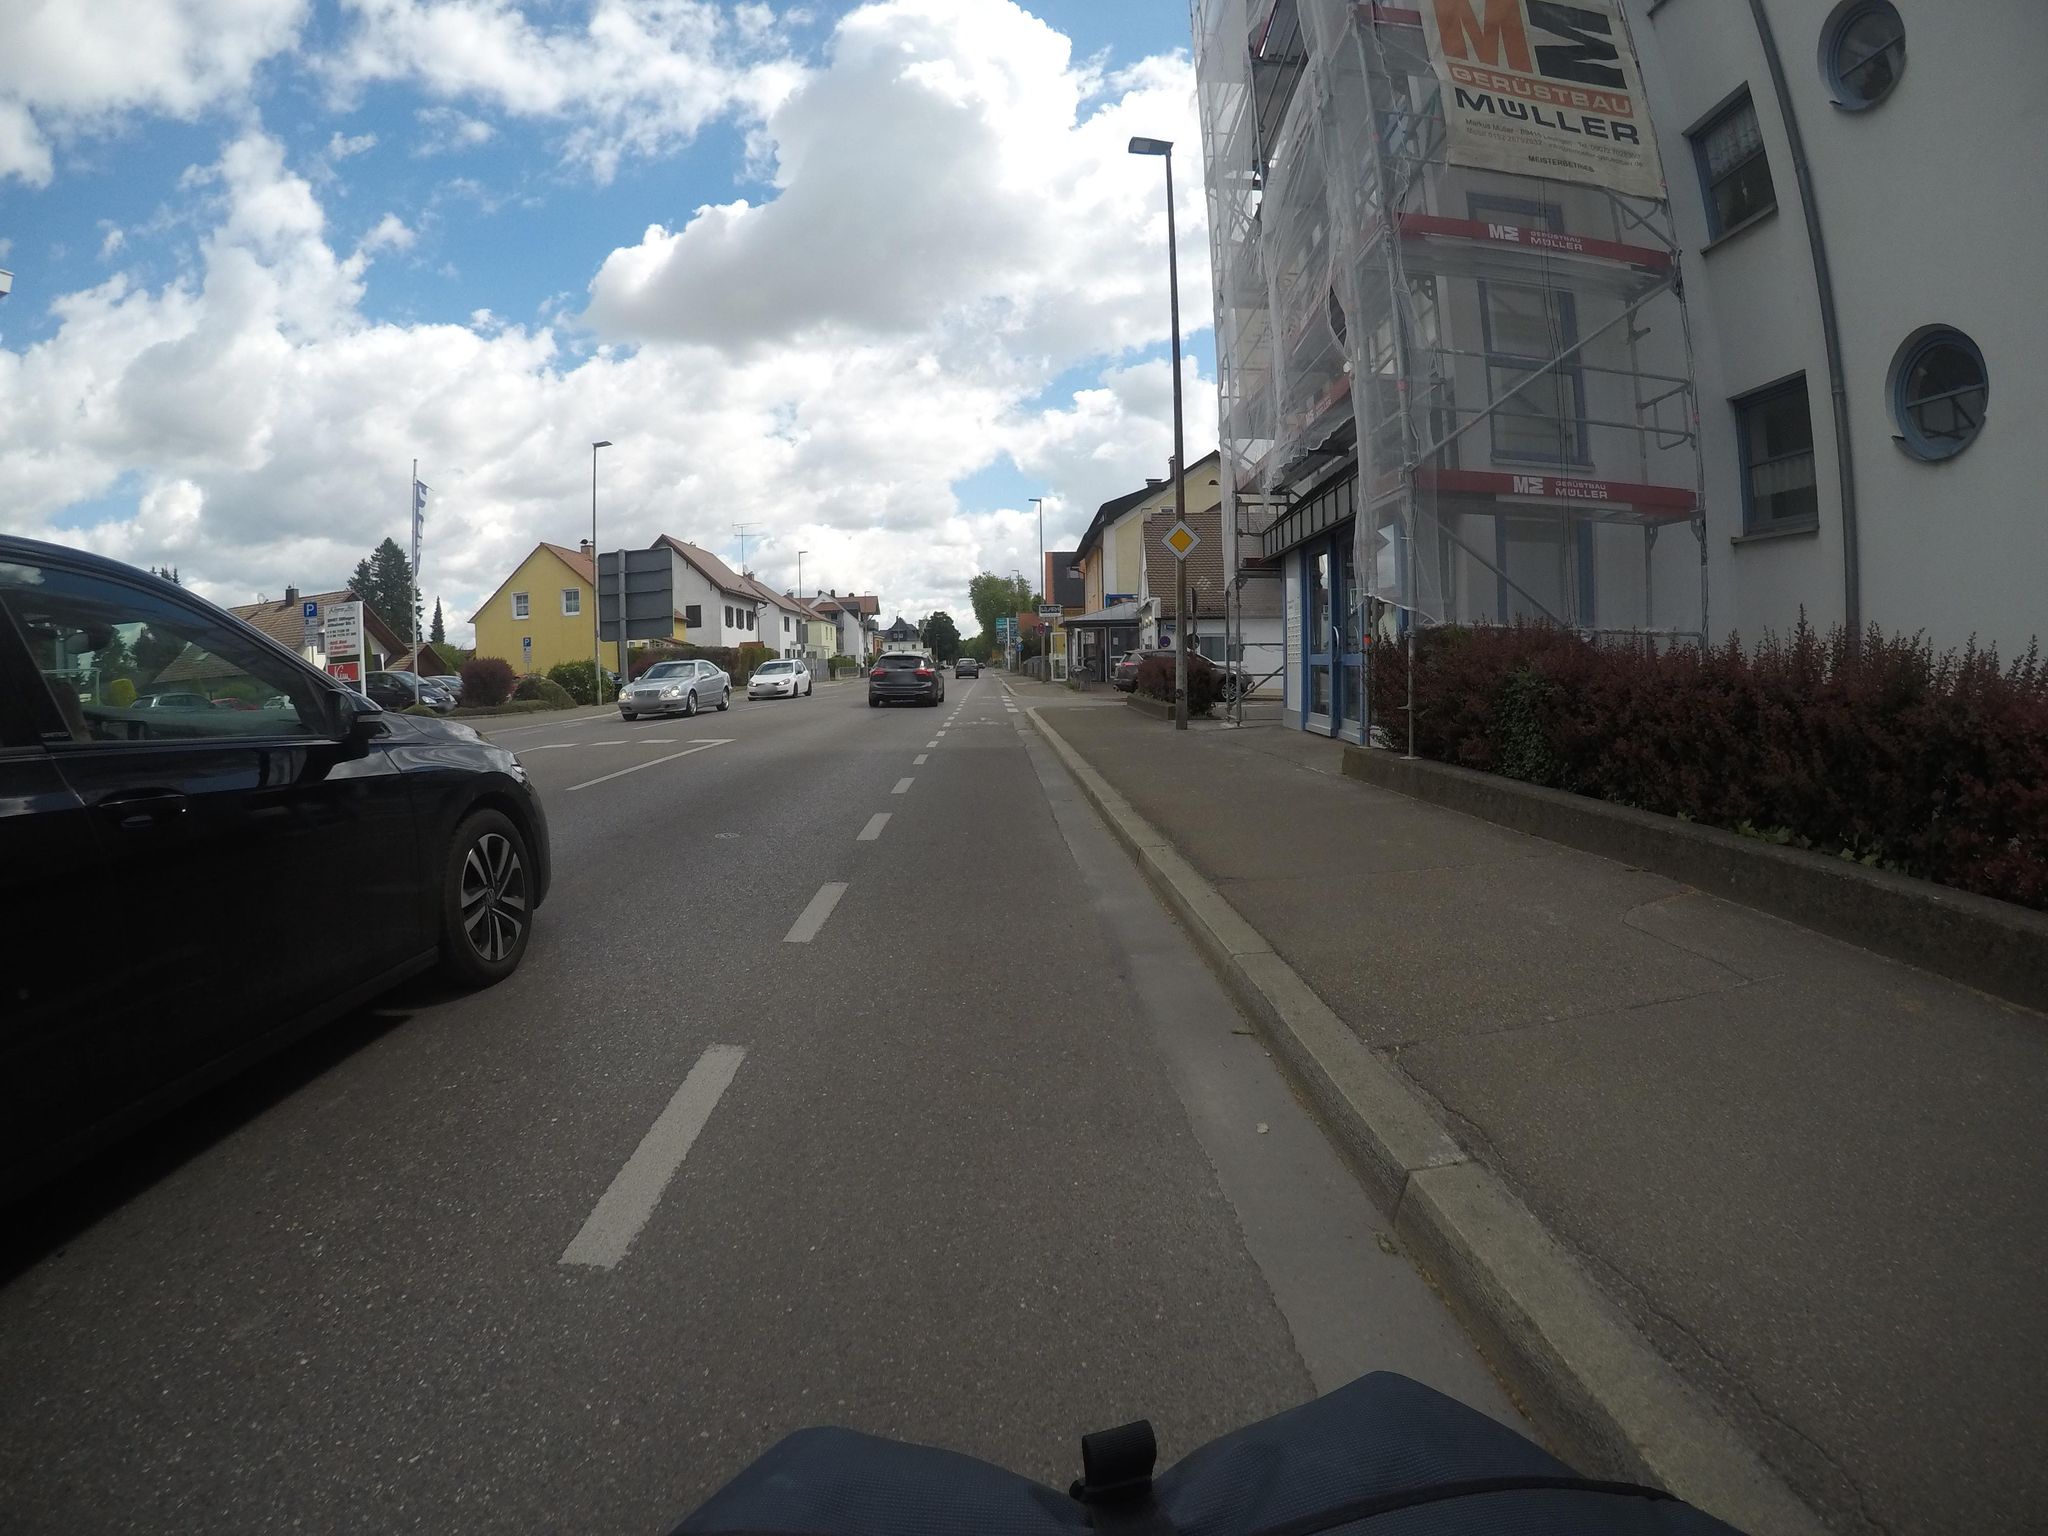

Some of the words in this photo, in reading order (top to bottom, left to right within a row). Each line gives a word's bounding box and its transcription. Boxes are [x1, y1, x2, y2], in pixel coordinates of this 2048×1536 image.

[1451, 66, 1632, 115] GERÜSTBAU
[1454, 87, 1641, 145] MÜLLER
[1530, 236, 1583, 251] MÜLLER
[1555, 487, 1608, 500] MÜLLER
